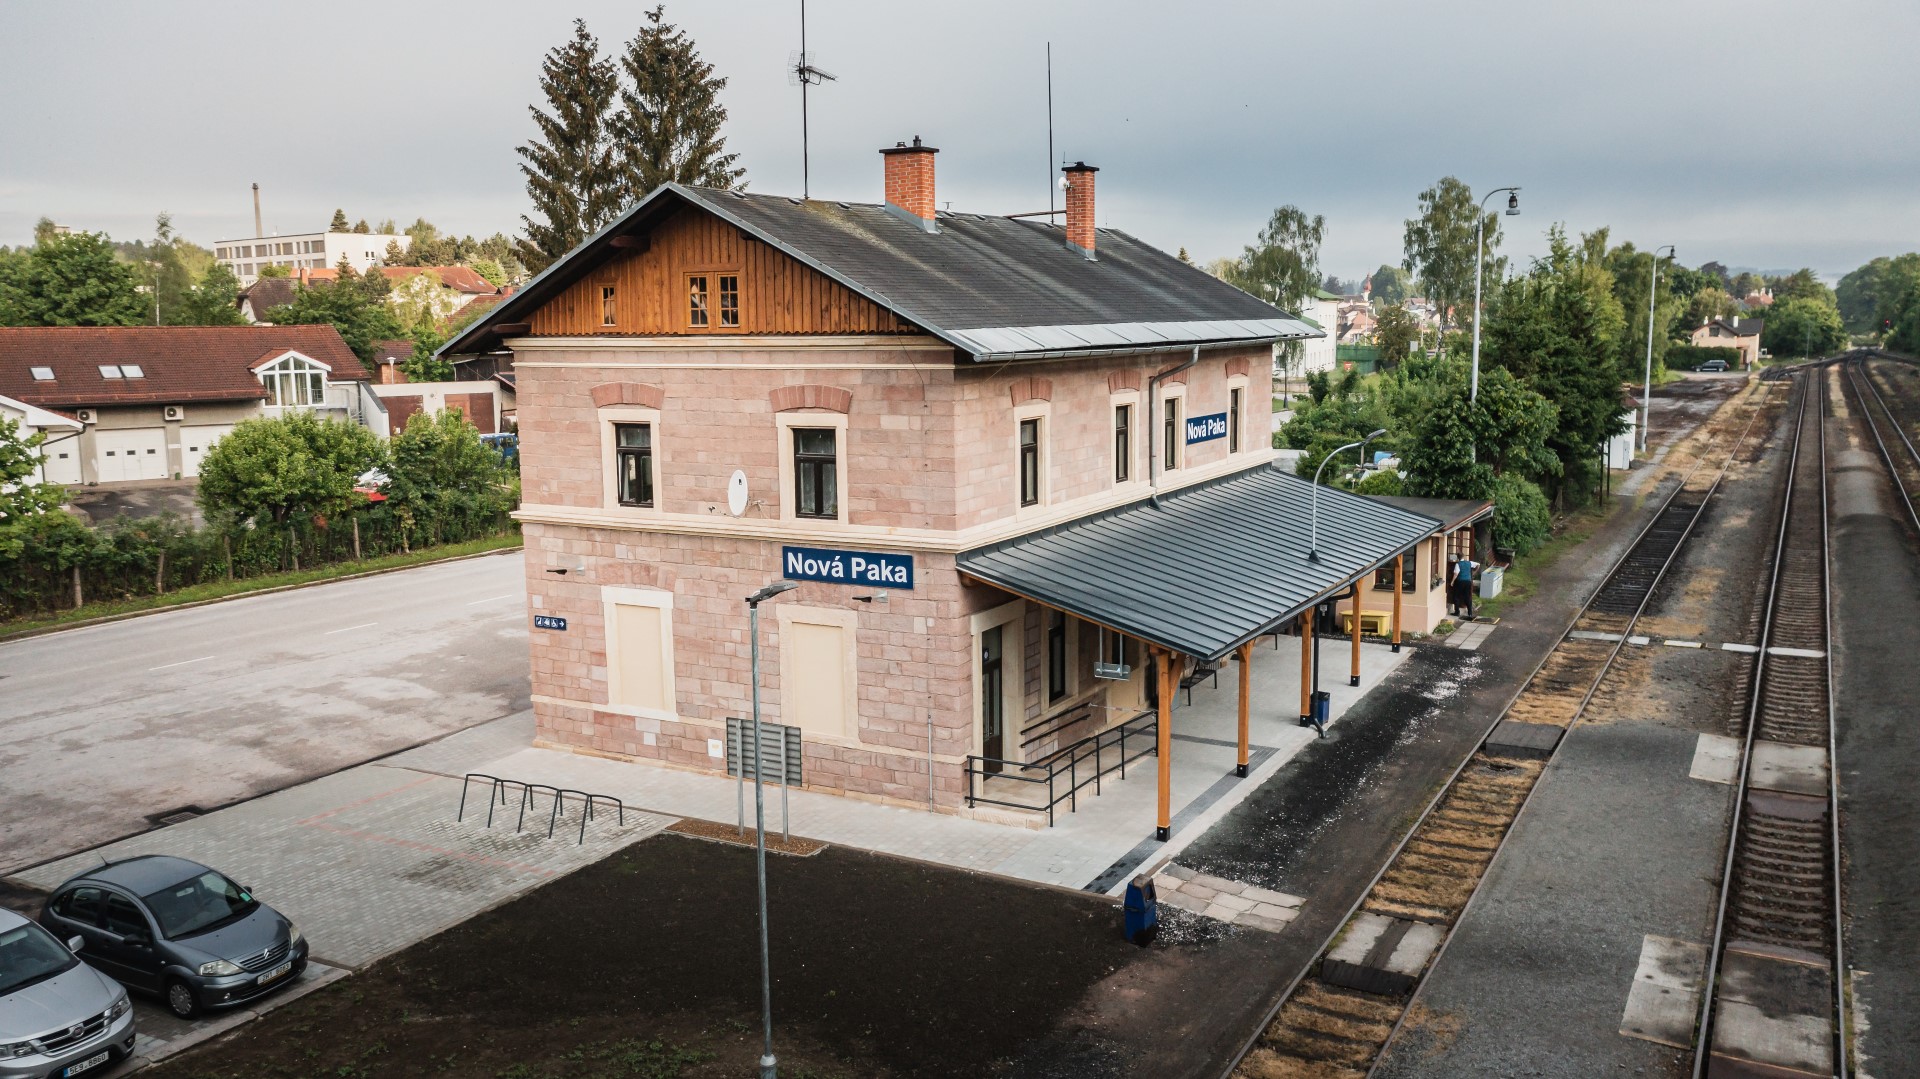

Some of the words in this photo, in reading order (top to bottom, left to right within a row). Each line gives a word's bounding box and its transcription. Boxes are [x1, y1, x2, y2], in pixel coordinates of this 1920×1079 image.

[1187, 420, 1206, 440] Nová
[1208, 418, 1225, 436] Paka
[787, 552, 844, 578] Nová
[851, 557, 908, 583] Paka
[70, 1063, 84, 1075] 5E9
